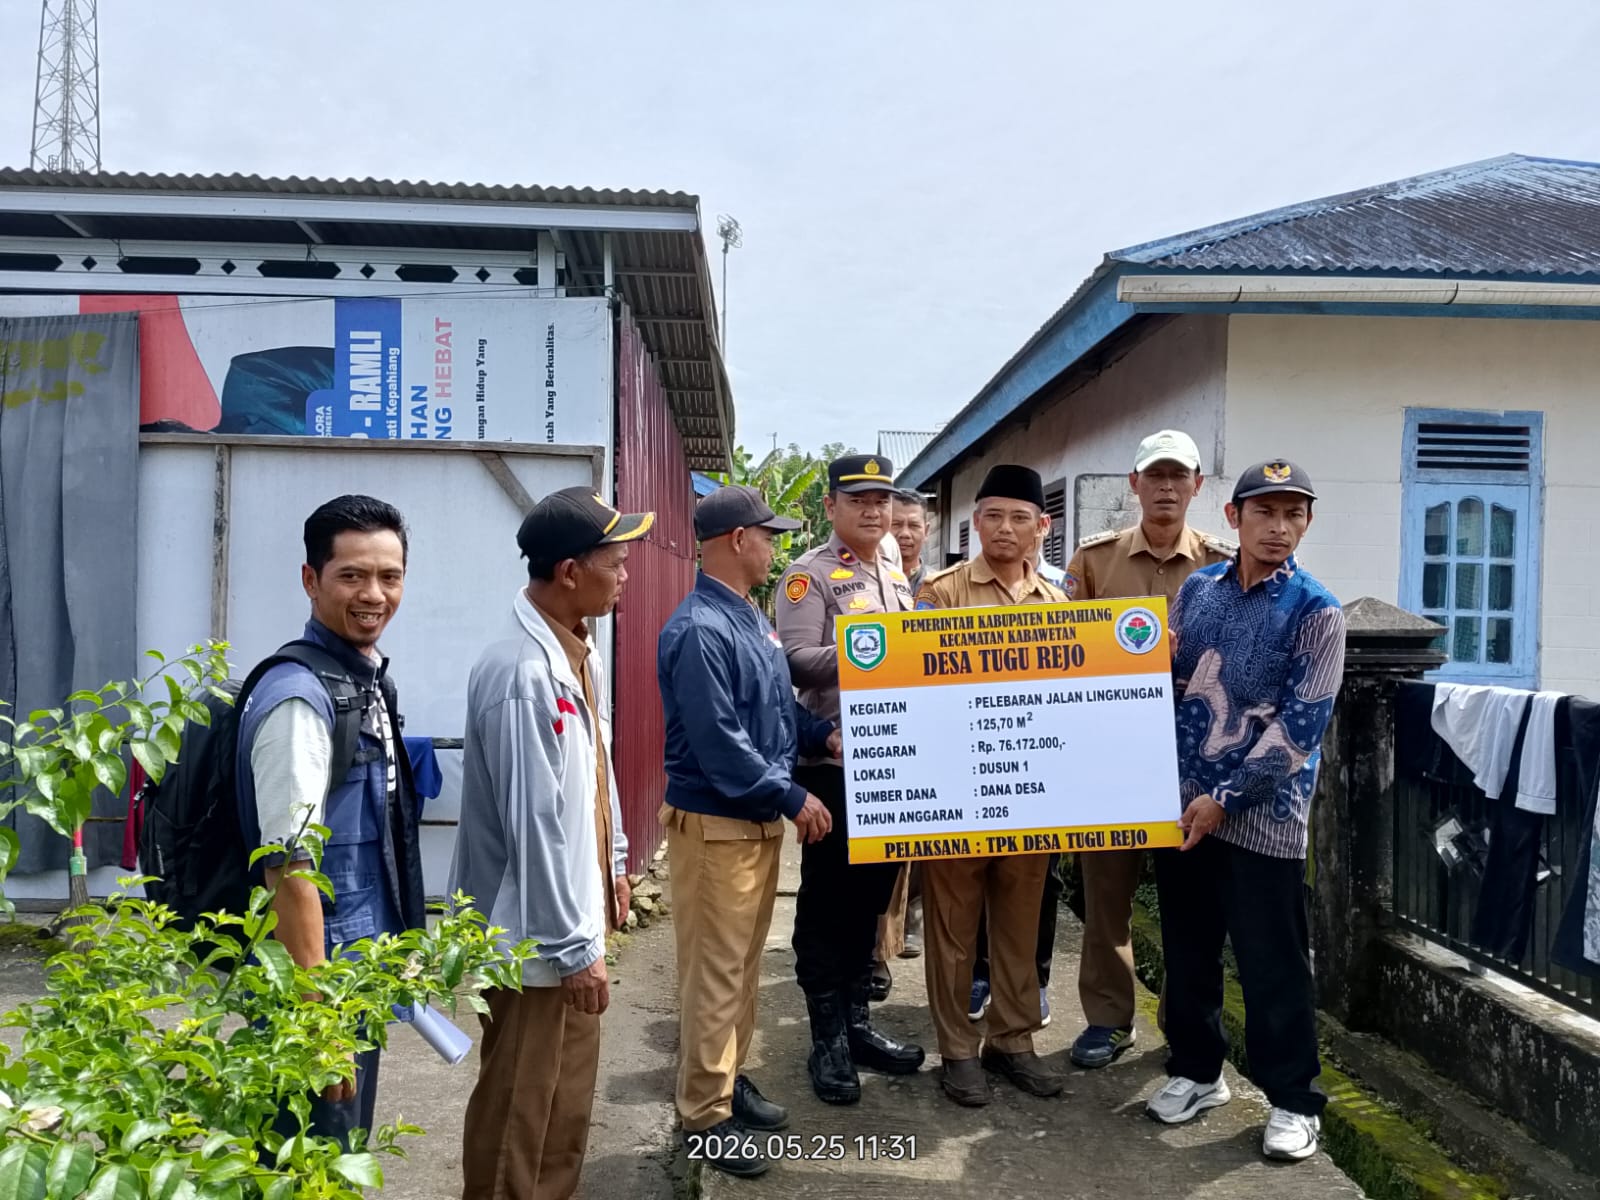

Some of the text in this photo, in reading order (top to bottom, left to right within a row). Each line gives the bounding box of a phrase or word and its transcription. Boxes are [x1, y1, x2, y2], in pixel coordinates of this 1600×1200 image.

[476, 338, 487, 366] Yang
[350, 331, 381, 411] RAMLI
[435, 317, 452, 440] NG HEBAT
[386, 347, 400, 440] ati Kepahiang
[476, 369, 487, 402] Hidup
[411, 385, 428, 439] HAN
[545, 390, 556, 418] Yang
[832, 582, 866, 596] DAVID
[902, 608, 1112, 633] PEMERINTAH KABUPATEN KEPAHIANG
[939, 627, 1076, 647] KECAMATAN KABAWETAN
[923, 644, 1085, 676] DESA TUGU REJO
[850, 701, 907, 716] KEGIATAN
[975, 693, 1042, 709] PELEBARAN
[1046, 691, 1083, 705] JALAN
[1086, 687, 1163, 702] LINGKUNGAN
[850, 724, 898, 737] VOLUME
[976, 717, 1013, 733] 125,70
[852, 745, 916, 760] ANGGARAN
[978, 741, 996, 754] Rp.
[999, 736, 1066, 751] 76.172.000,-
[853, 768, 895, 781] LOKASI
[979, 761, 1019, 774] DUSUN
[1023, 760, 1028, 772] 1
[855, 790, 902, 804] SUMBER
[906, 788, 937, 801] DANA
[981, 784, 1012, 797] DANA
[1015, 781, 1045, 795] DESA
[856, 812, 895, 826] TAHUN
[899, 808, 963, 823] ANGGARAN
[982, 806, 1009, 819] 2026
[884, 838, 971, 859] PELAKSANA
[986, 835, 1019, 852] TPK
[1023, 833, 1061, 851] DESA
[1065, 831, 1105, 849] TUGU
[1110, 829, 1148, 848] REJO
